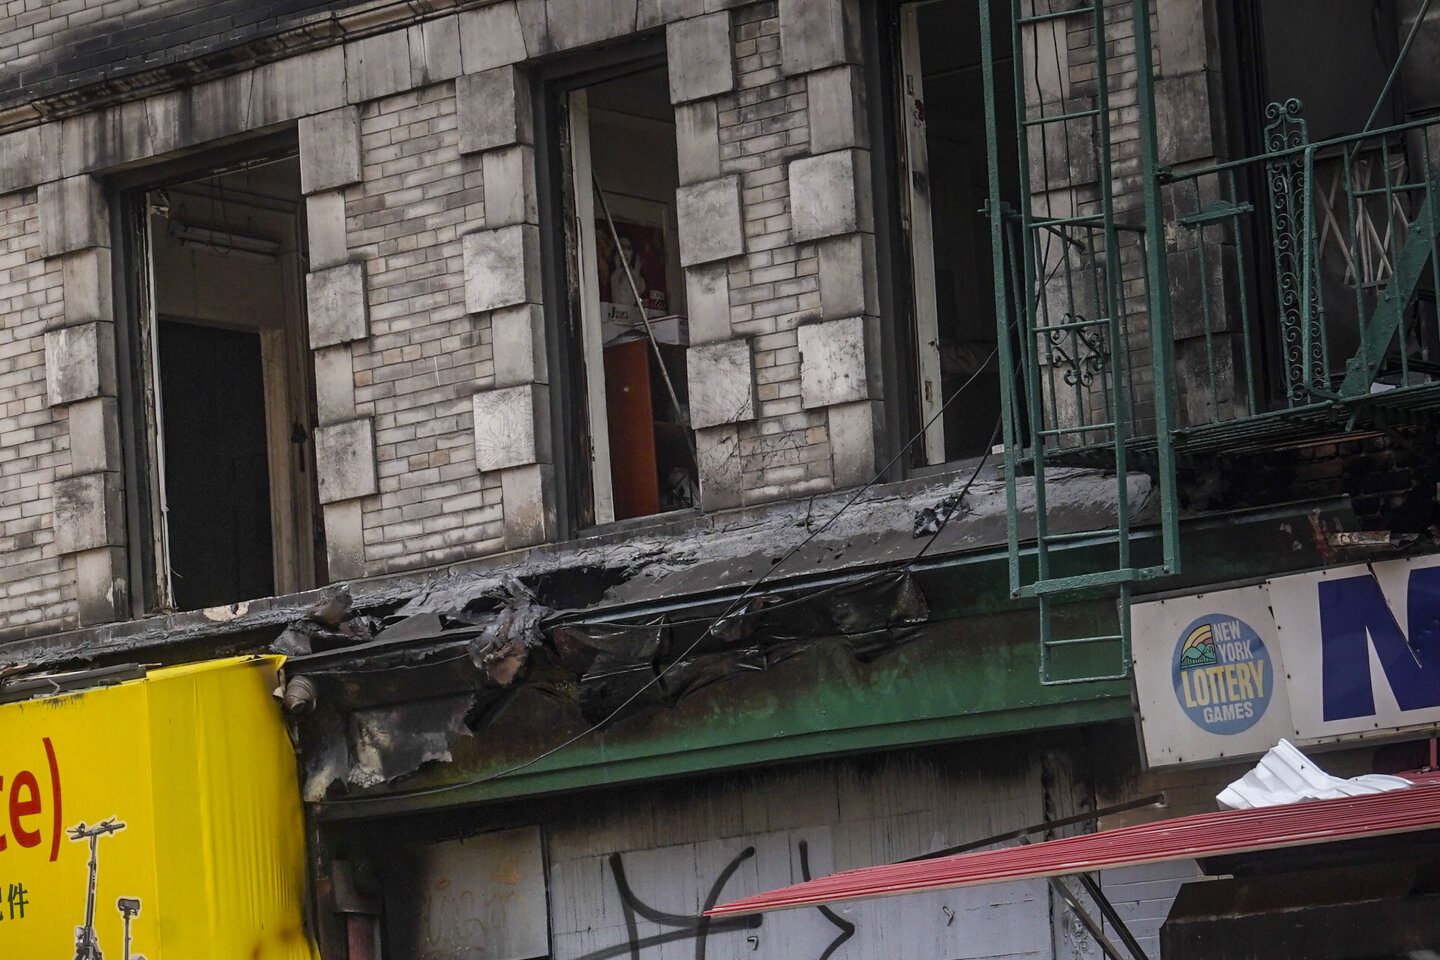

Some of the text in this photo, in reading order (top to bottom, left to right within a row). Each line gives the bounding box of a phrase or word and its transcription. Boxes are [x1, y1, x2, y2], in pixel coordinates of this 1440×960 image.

[1213, 620, 1240, 642] NEW
[1218, 640, 1254, 663] YORK
[1181, 660, 1264, 708] LOTTERY
[1203, 701, 1254, 723] GAMES
